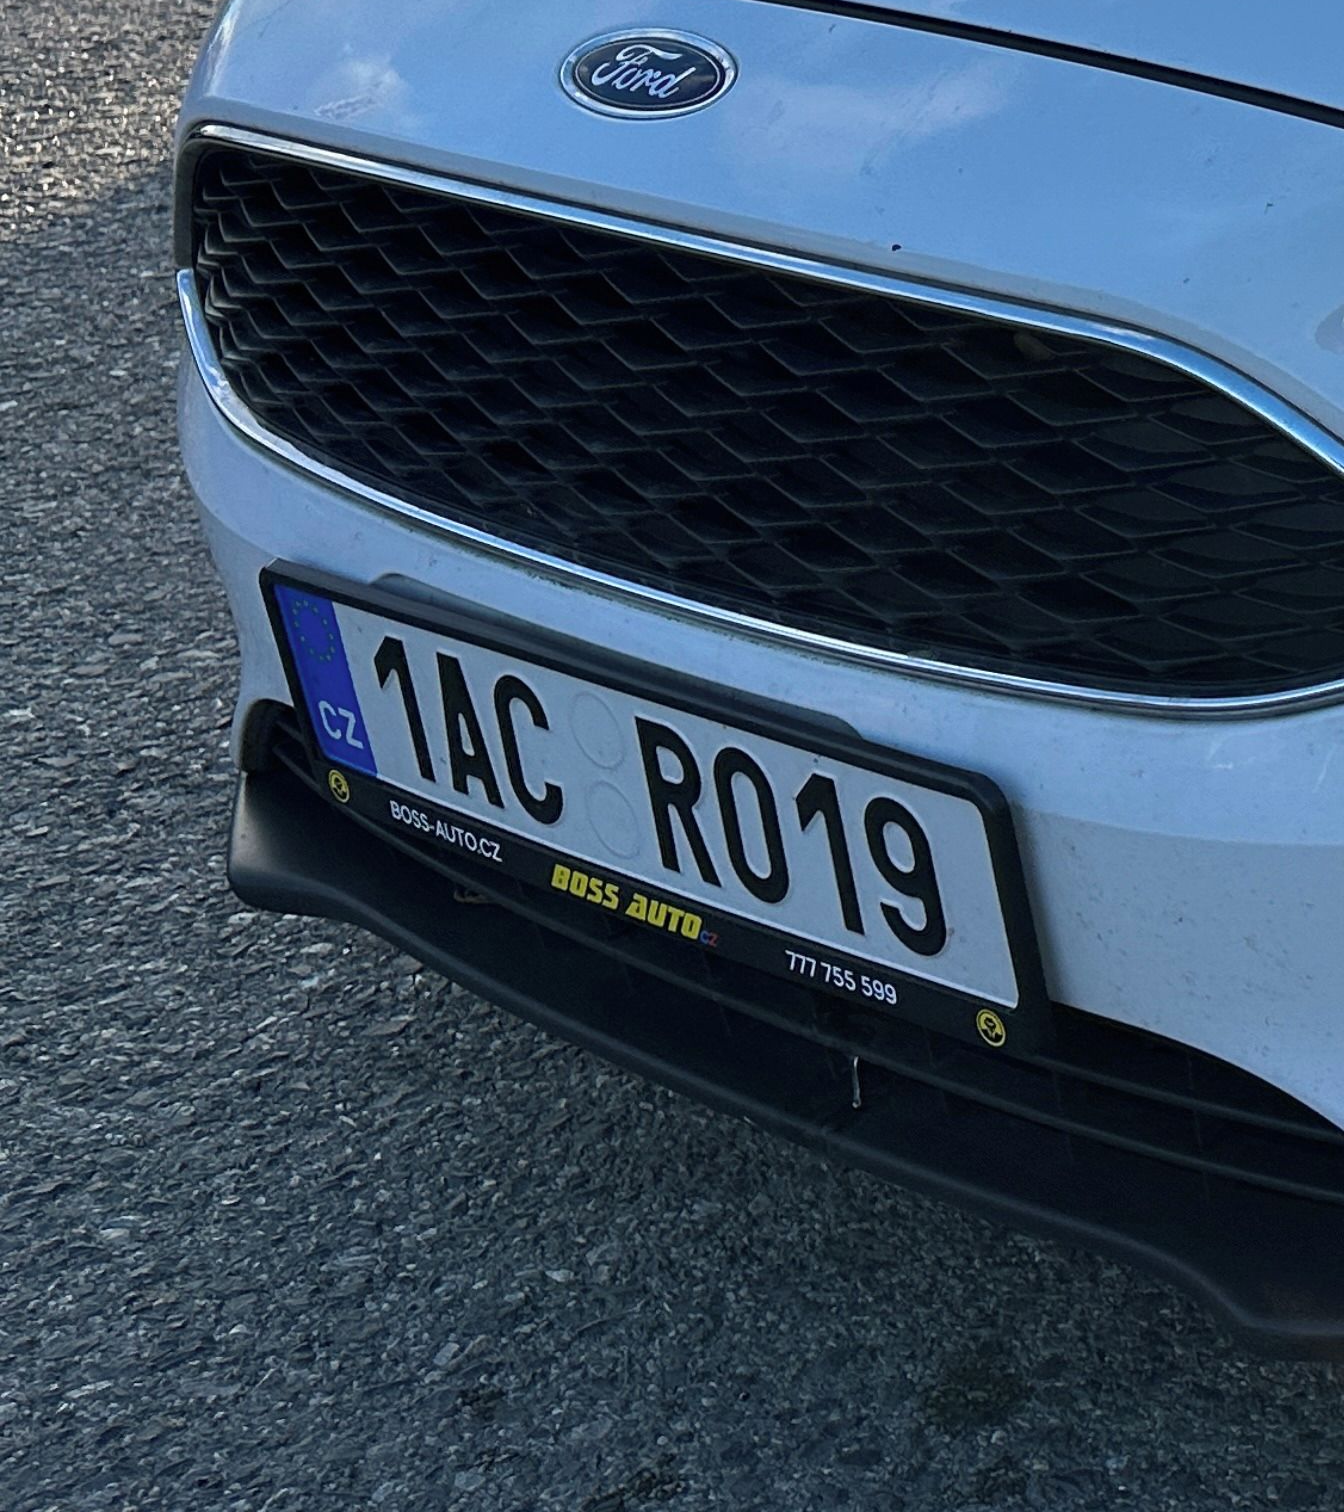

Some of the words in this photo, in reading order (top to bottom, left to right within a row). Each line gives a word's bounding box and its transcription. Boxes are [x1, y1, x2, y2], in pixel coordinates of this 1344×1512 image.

[592, 44, 696, 99] Ford
[317, 700, 364, 749] CZ
[374, 636, 564, 824] 1AC
[634, 716, 948, 956] R019
[389, 800, 503, 862] BOSS-AUTO.CZ
[551, 864, 619, 910] BOSS
[625, 892, 703, 940] AUTO
[785, 950, 817, 977] 777
[820, 961, 856, 991] 755
[861, 975, 898, 1004] 599
